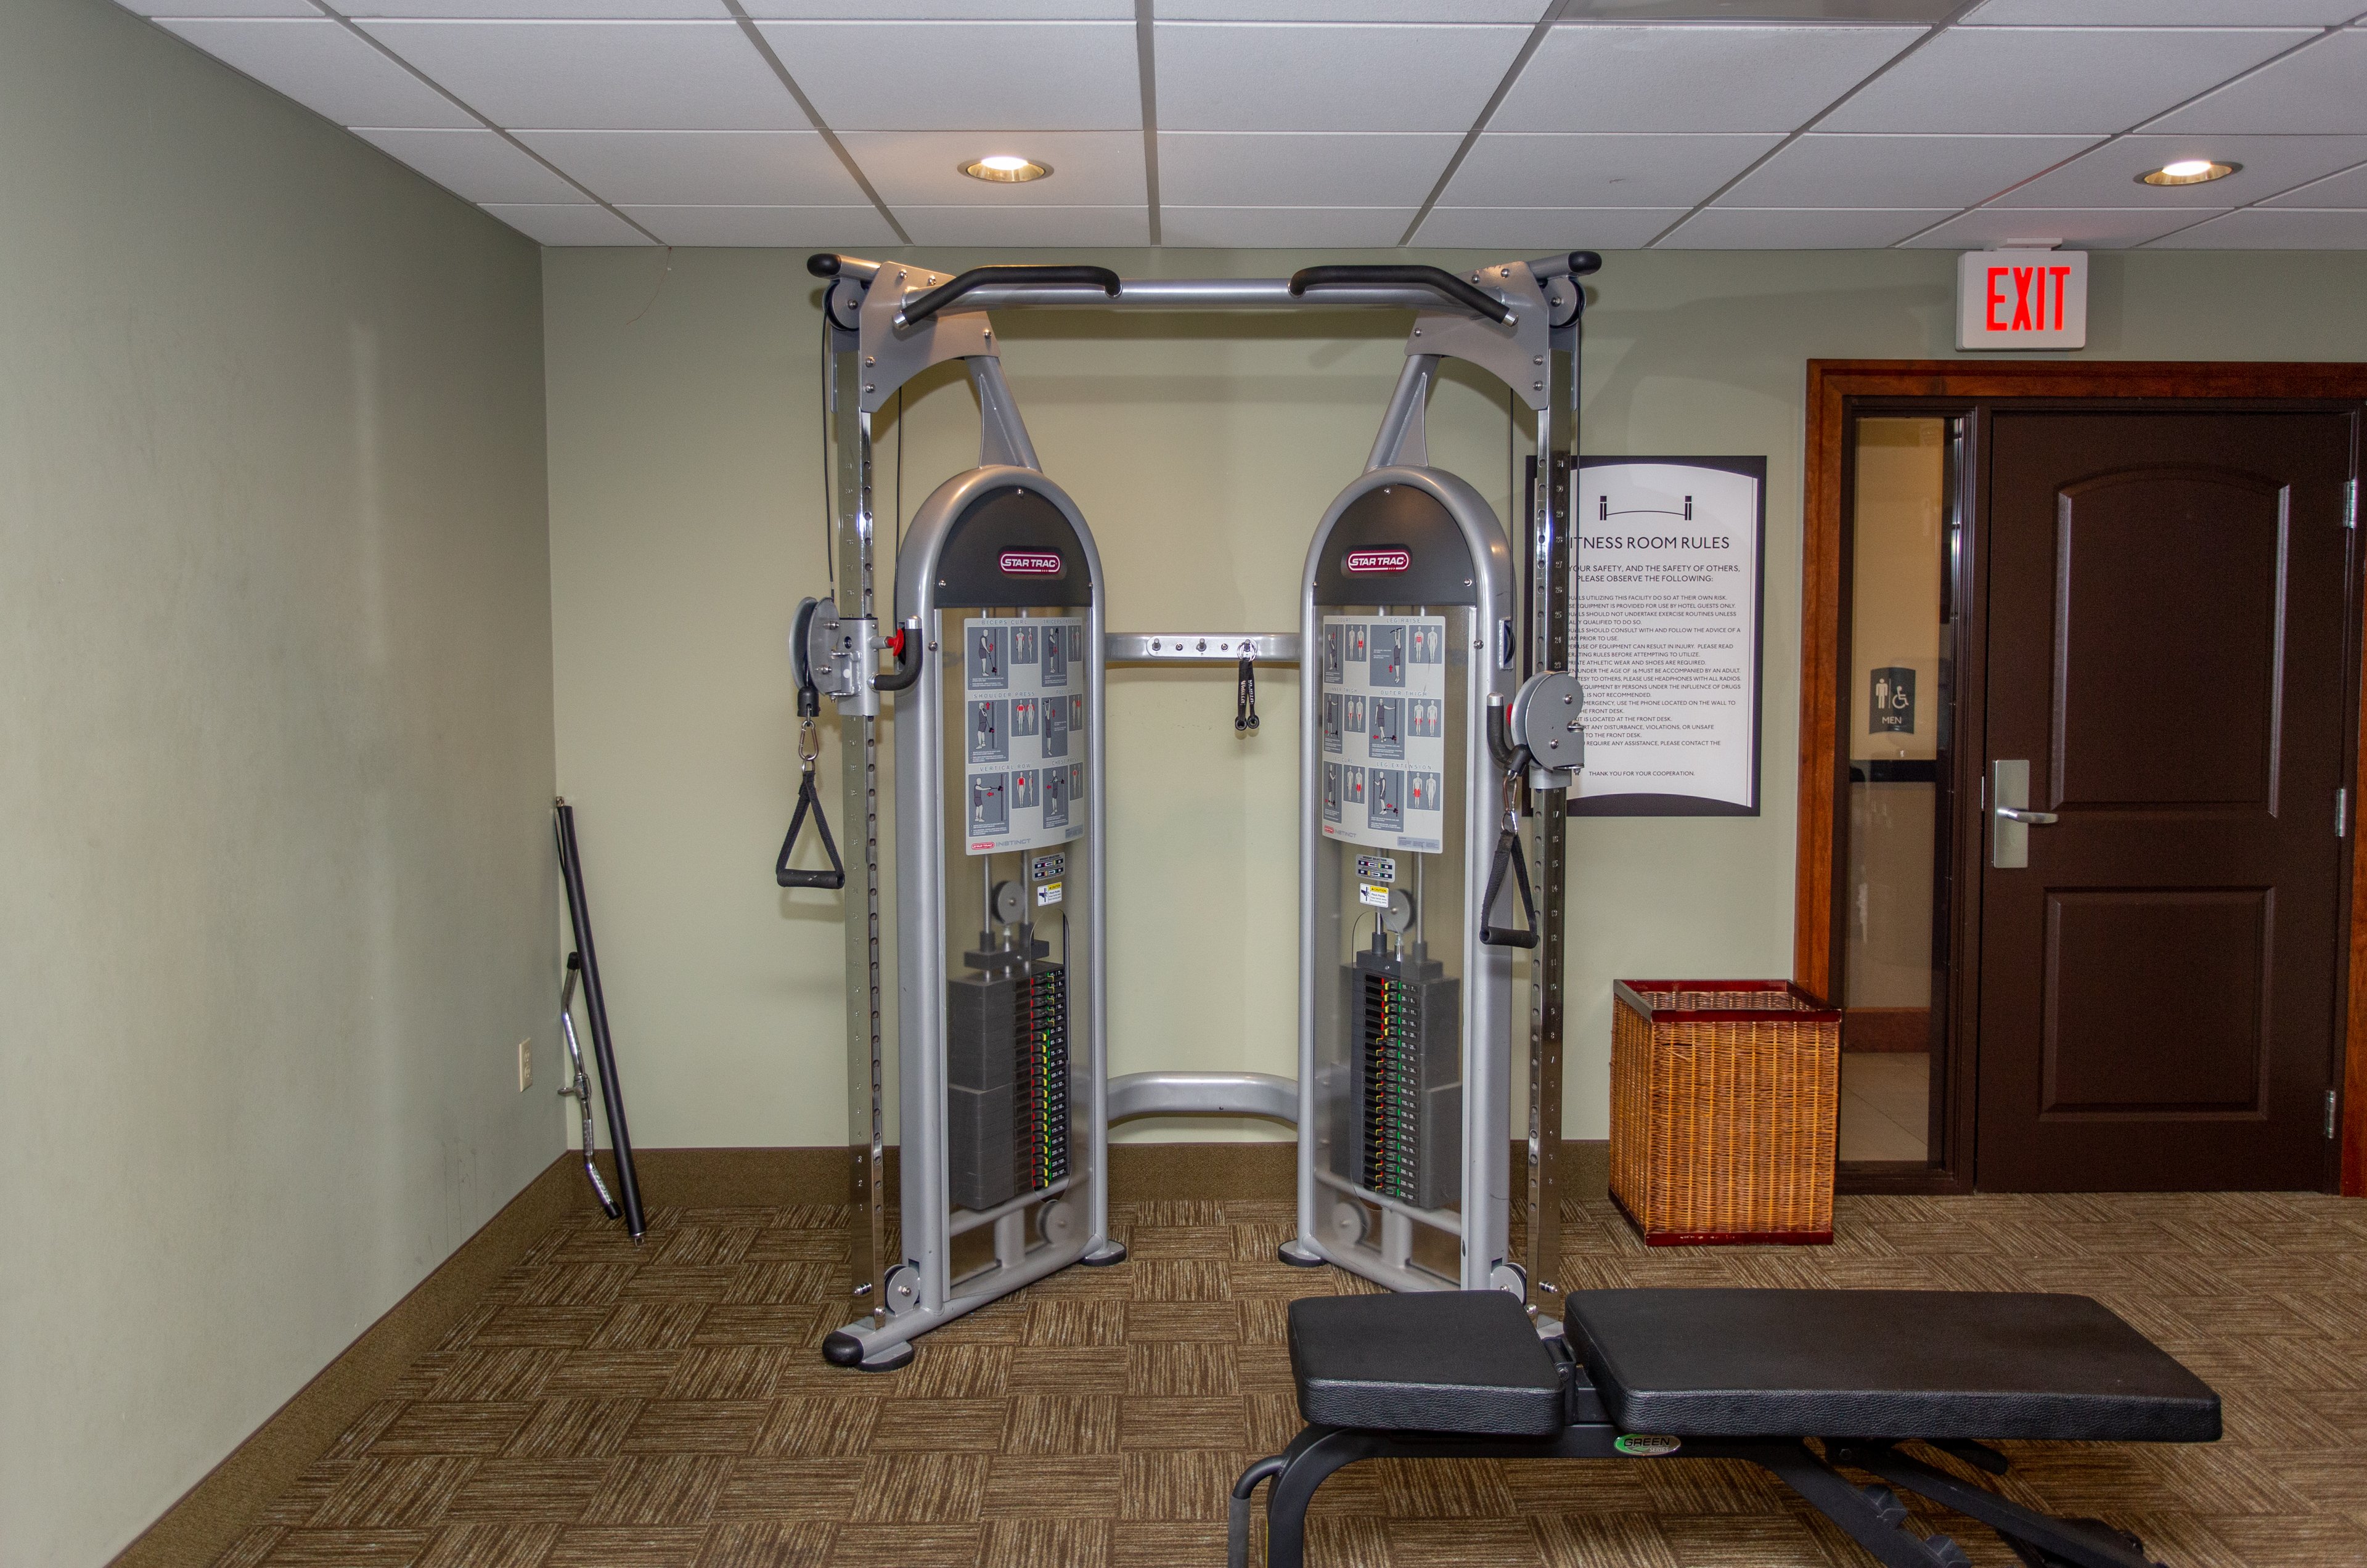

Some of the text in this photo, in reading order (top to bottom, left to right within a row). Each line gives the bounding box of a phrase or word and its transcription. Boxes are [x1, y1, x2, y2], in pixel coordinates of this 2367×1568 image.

[1985, 266, 2071, 331] EXIT
[1570, 537, 1730, 549] ITNESS ROOM RULES
[1002, 558, 1056, 568] STAR TRAC
[1349, 557, 1404, 566] STAR TRAC
[1882, 716, 1902, 724] MEN
[1391, 762, 1433, 770] EXTENSION
[1624, 1437, 1670, 1447] GREEN
